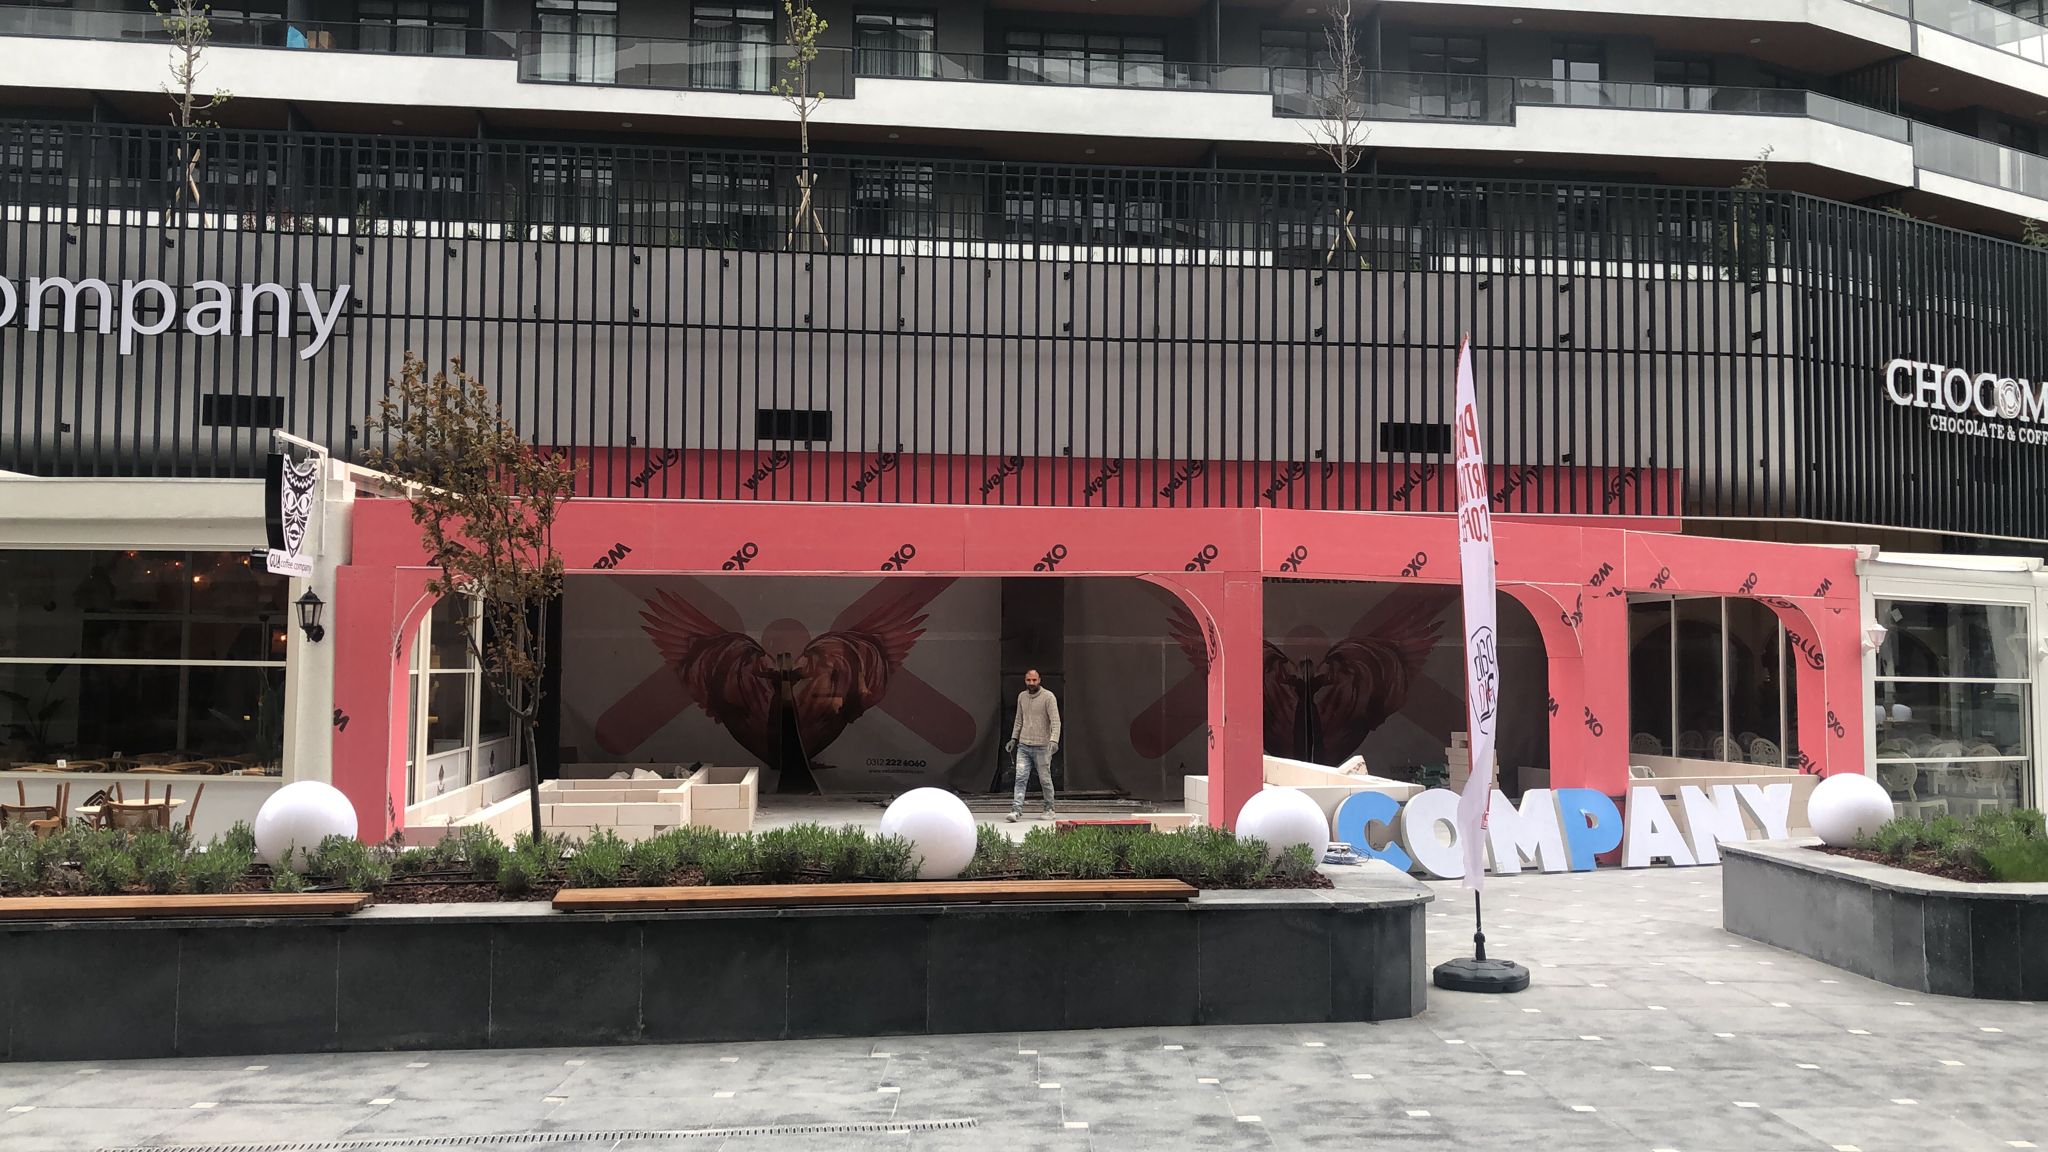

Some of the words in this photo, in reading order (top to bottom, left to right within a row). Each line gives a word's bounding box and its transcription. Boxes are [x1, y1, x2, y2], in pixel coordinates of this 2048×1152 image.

[1930, 414, 2005, 440] CHOCOLATE
[2007, 426, 2016, 442] &
[885, 758, 902, 767] 222
[1334, 783, 1793, 879] COMPANY
